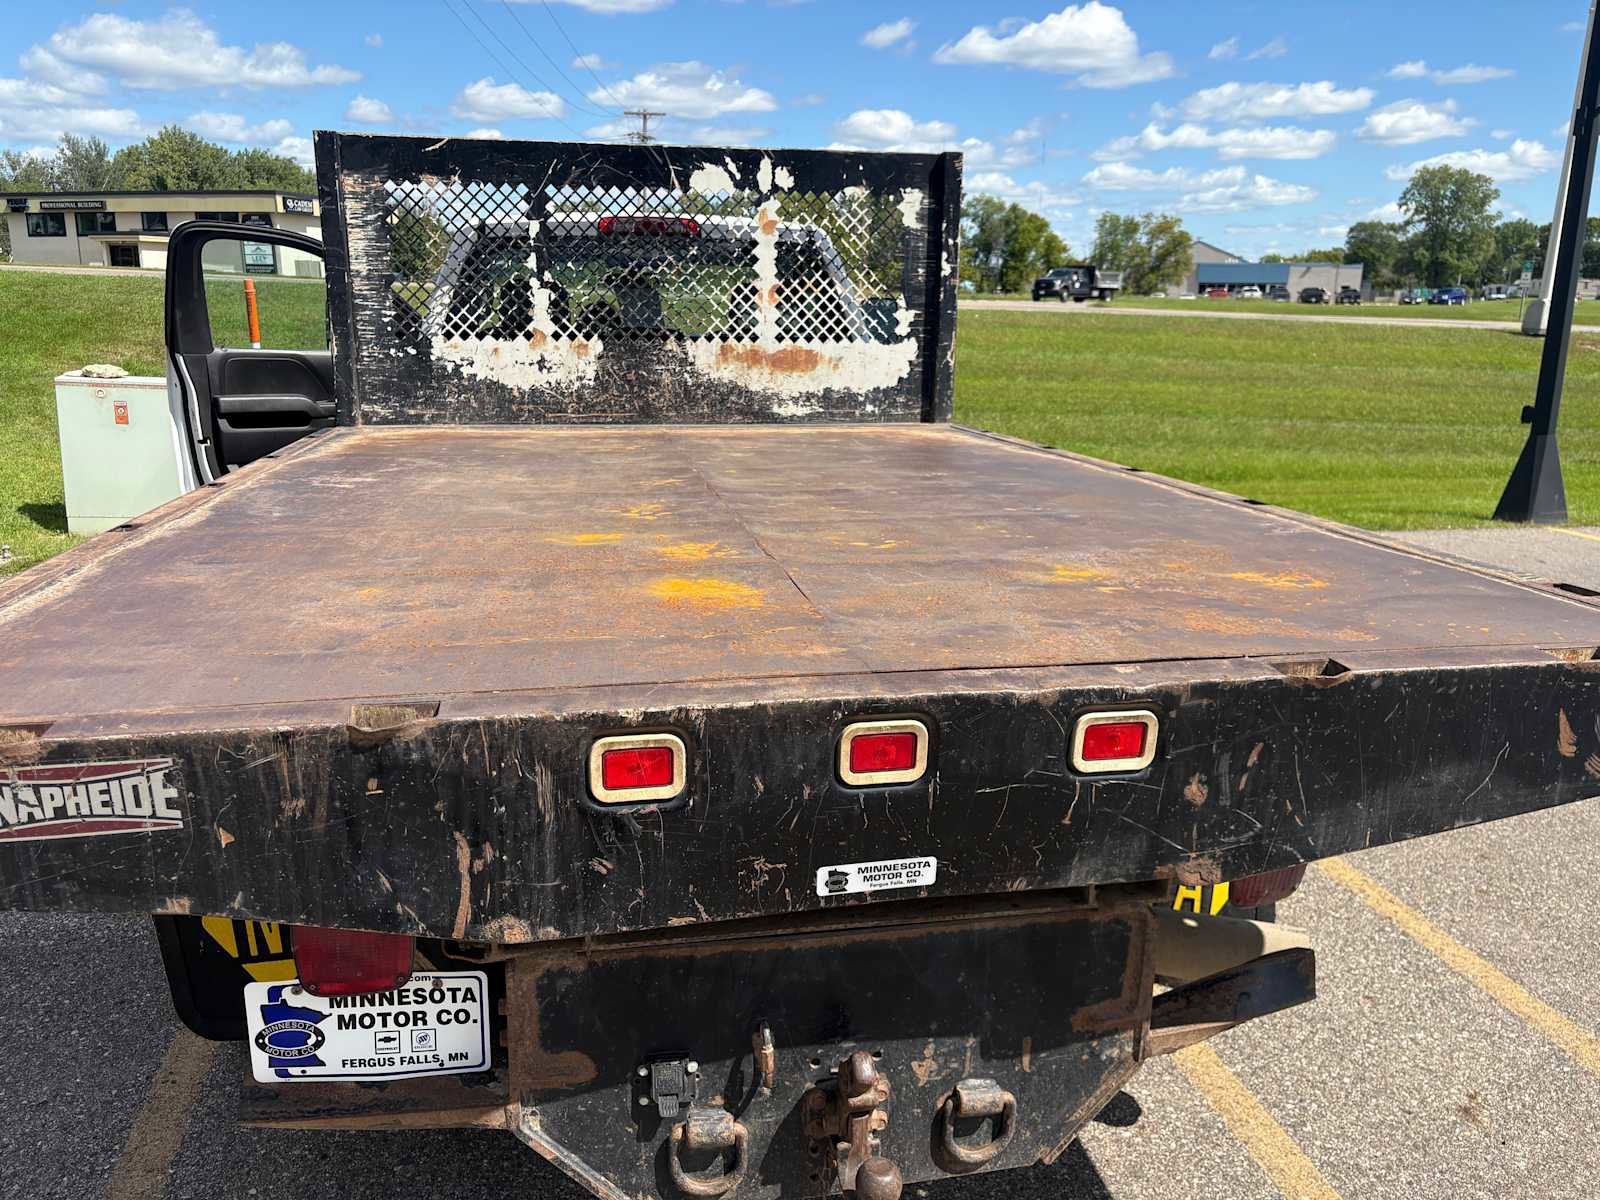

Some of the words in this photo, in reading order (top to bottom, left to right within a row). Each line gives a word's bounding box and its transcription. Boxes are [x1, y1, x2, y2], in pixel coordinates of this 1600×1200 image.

[0, 769, 183, 828] NAPHEIDE
[857, 861, 931, 875] MINNESOTA
[863, 871, 902, 883] MOTOR
[906, 869, 924, 879] CO.
[328, 987, 478, 1009] MINNESOTA
[337, 1010, 428, 1030] MOTOR
[436, 1008, 478, 1025] CO.
[262, 1021, 315, 1036] MINNESOTA
[264, 1046, 299, 1057] MOTOR
[341, 1057, 395, 1068] FERGUS
[400, 1054, 444, 1066] FALLS,
[448, 1052, 469, 1062] MN
